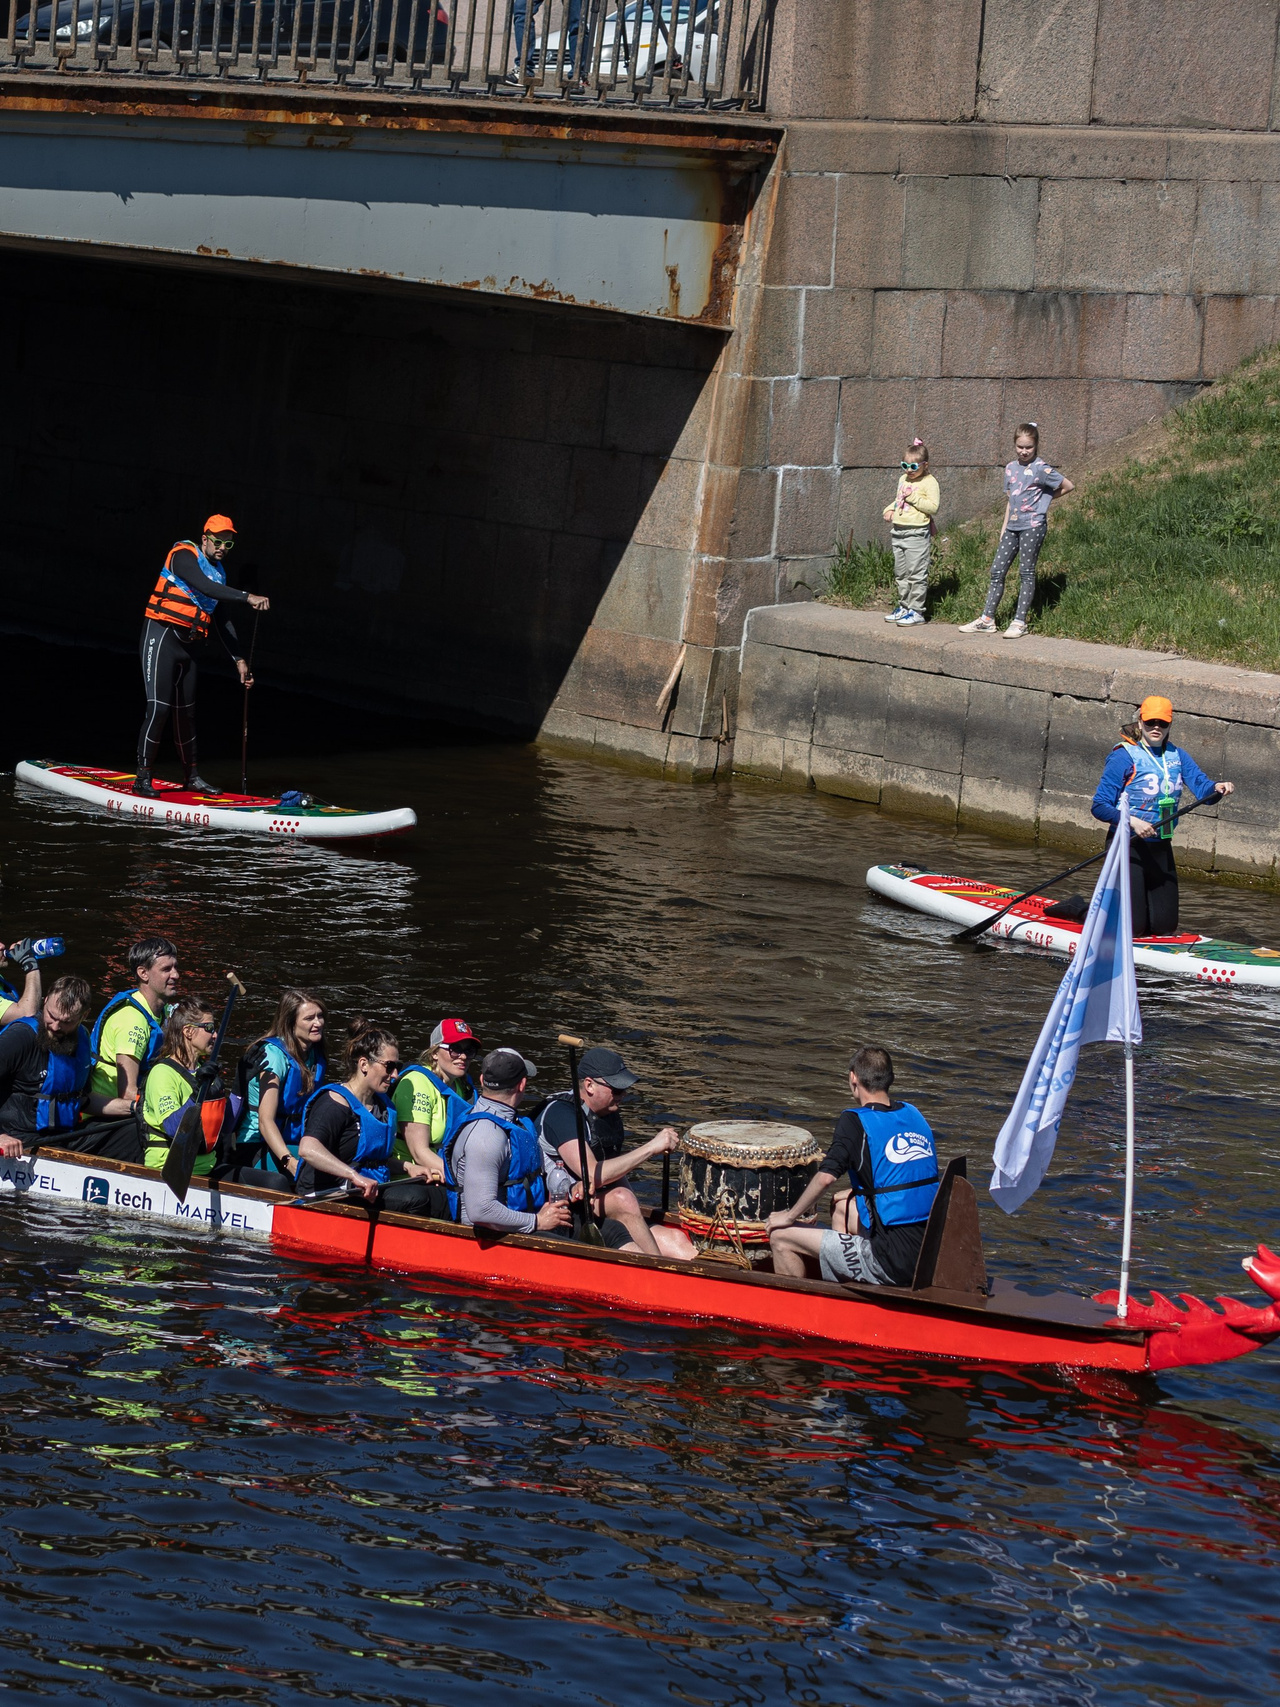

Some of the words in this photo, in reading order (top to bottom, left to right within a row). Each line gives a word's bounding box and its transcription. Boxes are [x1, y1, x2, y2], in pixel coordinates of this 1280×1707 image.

[133, 804, 154, 818] SUP
[1025, 930, 1054, 948] SUP
[114, 1188, 152, 1210] tech
[176, 1202, 254, 1230] MARVEL
